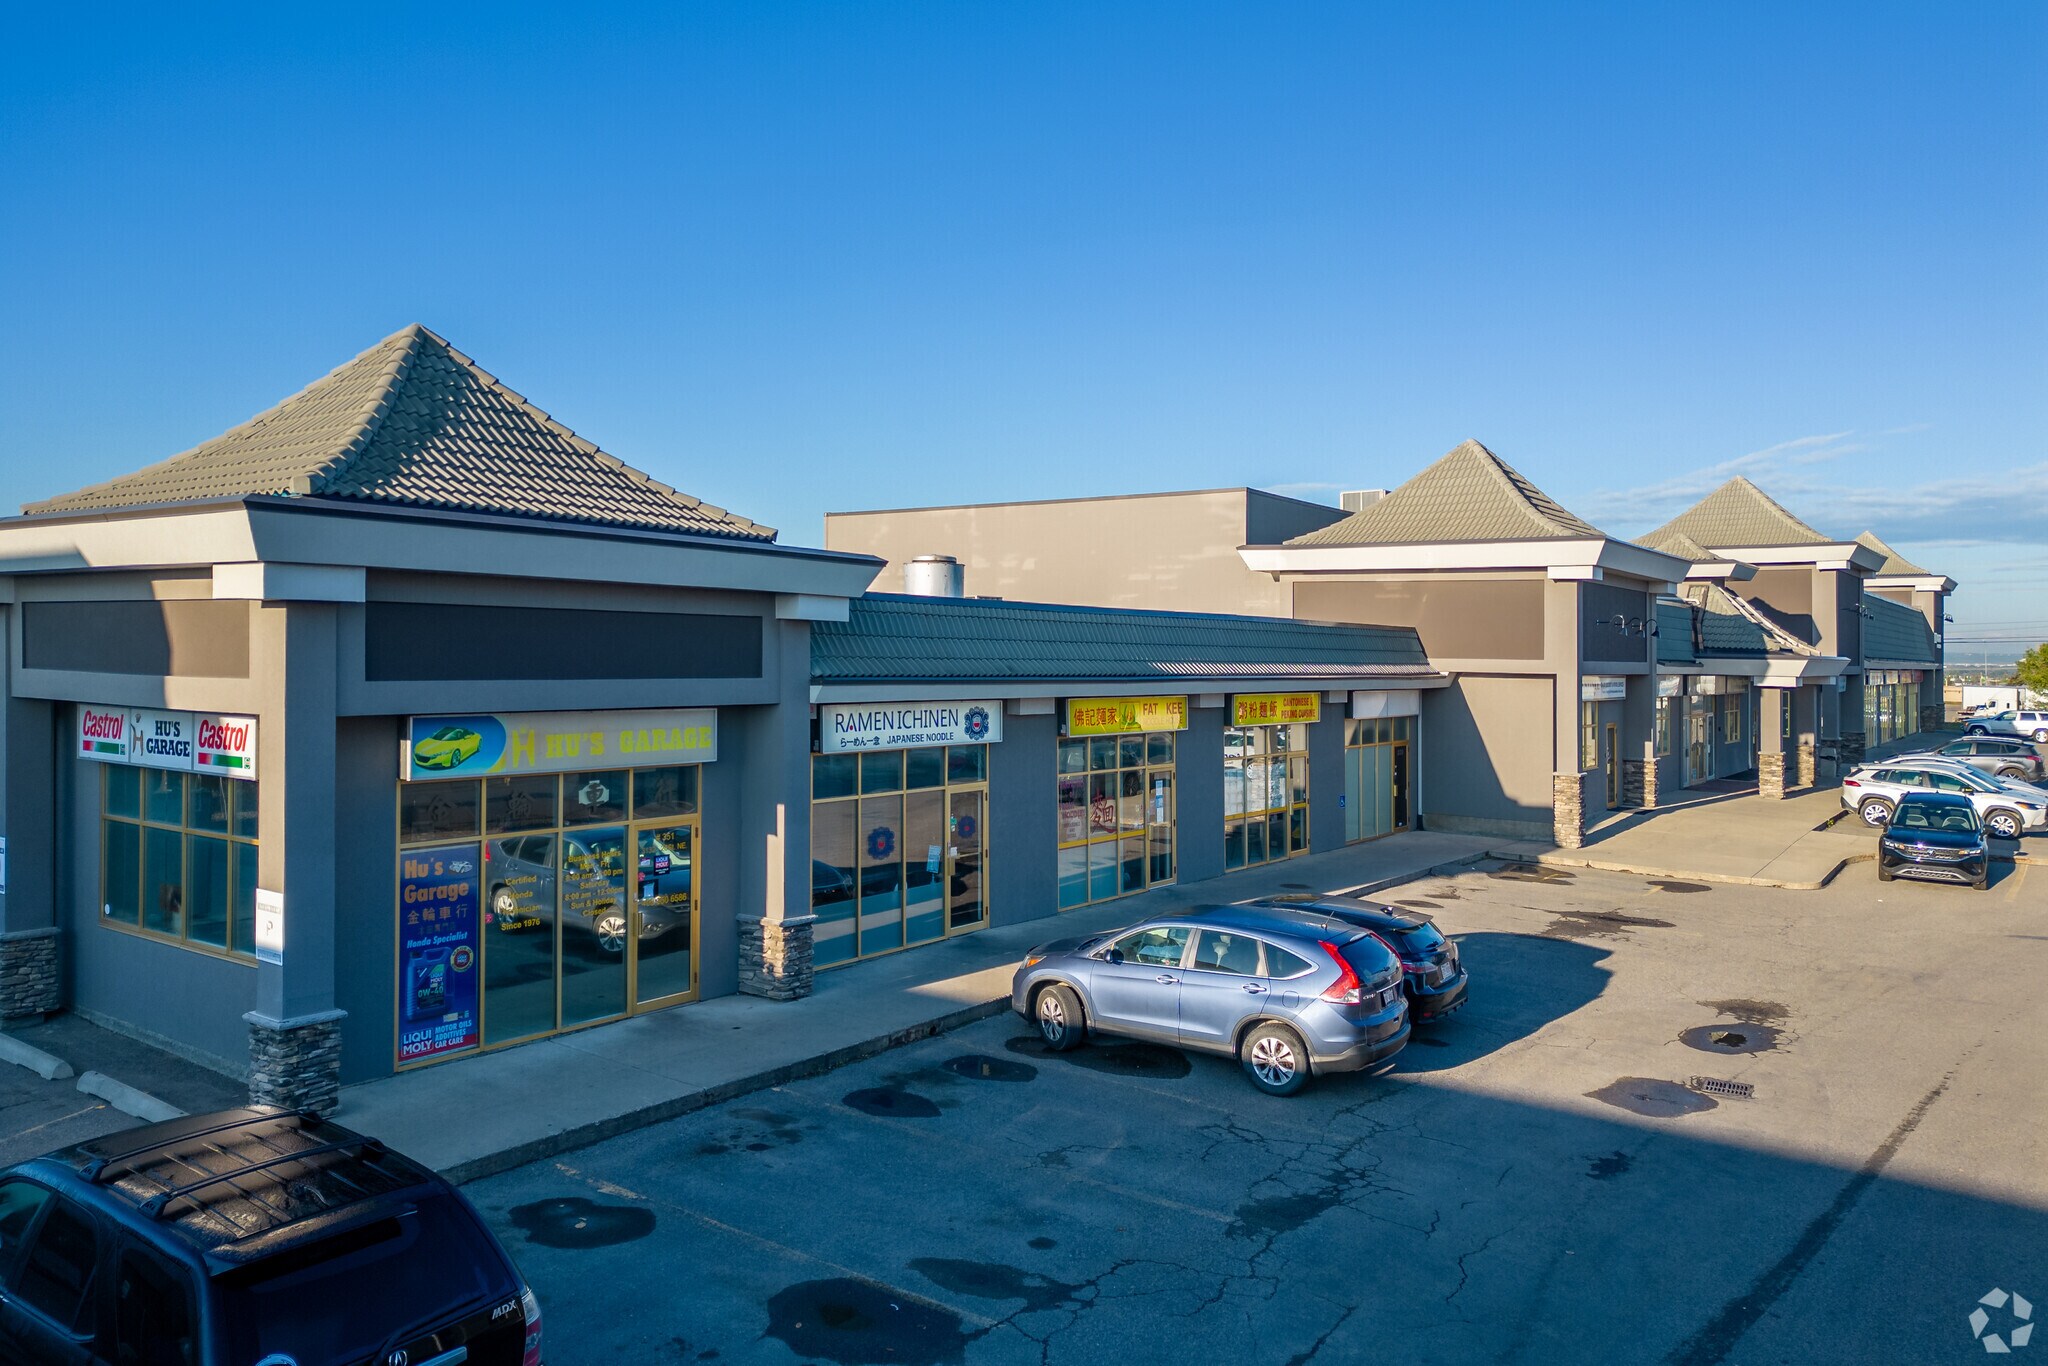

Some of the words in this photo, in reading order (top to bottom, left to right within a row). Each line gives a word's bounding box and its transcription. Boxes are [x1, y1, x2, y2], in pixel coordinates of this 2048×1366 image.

[1143, 703, 1158, 715] FAT
[1166, 702, 1183, 715] KEE
[82, 710, 125, 740] Castrol
[835, 711, 894, 733] RAMEN
[897, 708, 959, 730] ICHINEN
[155, 720, 181, 738] HU'S
[198, 719, 249, 752] Castrol
[545, 732, 605, 758] HU'S
[619, 726, 712, 754] GARAGE
[887, 733, 925, 745] JAPANESE
[926, 732, 954, 742] NOODLE
[146, 738, 190, 757] GARAGE
[662, 832, 675, 841] 351
[568, 853, 599, 862] Business
[601, 850, 622, 858] Hours
[404, 857, 444, 879] Hu's
[613, 869, 623, 877] pm
[505, 874, 537, 886] Certified
[580, 880, 610, 888] Saturday
[404, 882, 470, 904] Garage
[508, 890, 533, 899] Honda
[670, 892, 688, 902] 6586
[501, 922, 522, 931] Since
[523, 918, 541, 927] 1976
[407, 937, 431, 949] Honda
[432, 931, 468, 945] Specialist
[417, 986, 444, 998] 0W-40
[435, 1022, 458, 1034] MOTOR
[458, 1019, 472, 1028] OILS
[403, 1029, 432, 1045] LIQUI
[434, 1028, 466, 1042] ADDITIVES
[403, 1040, 433, 1055] MOLY
[434, 1040, 447, 1049] CAR
[448, 1036, 464, 1045] CARE
[491, 1300, 517, 1320] MDX
